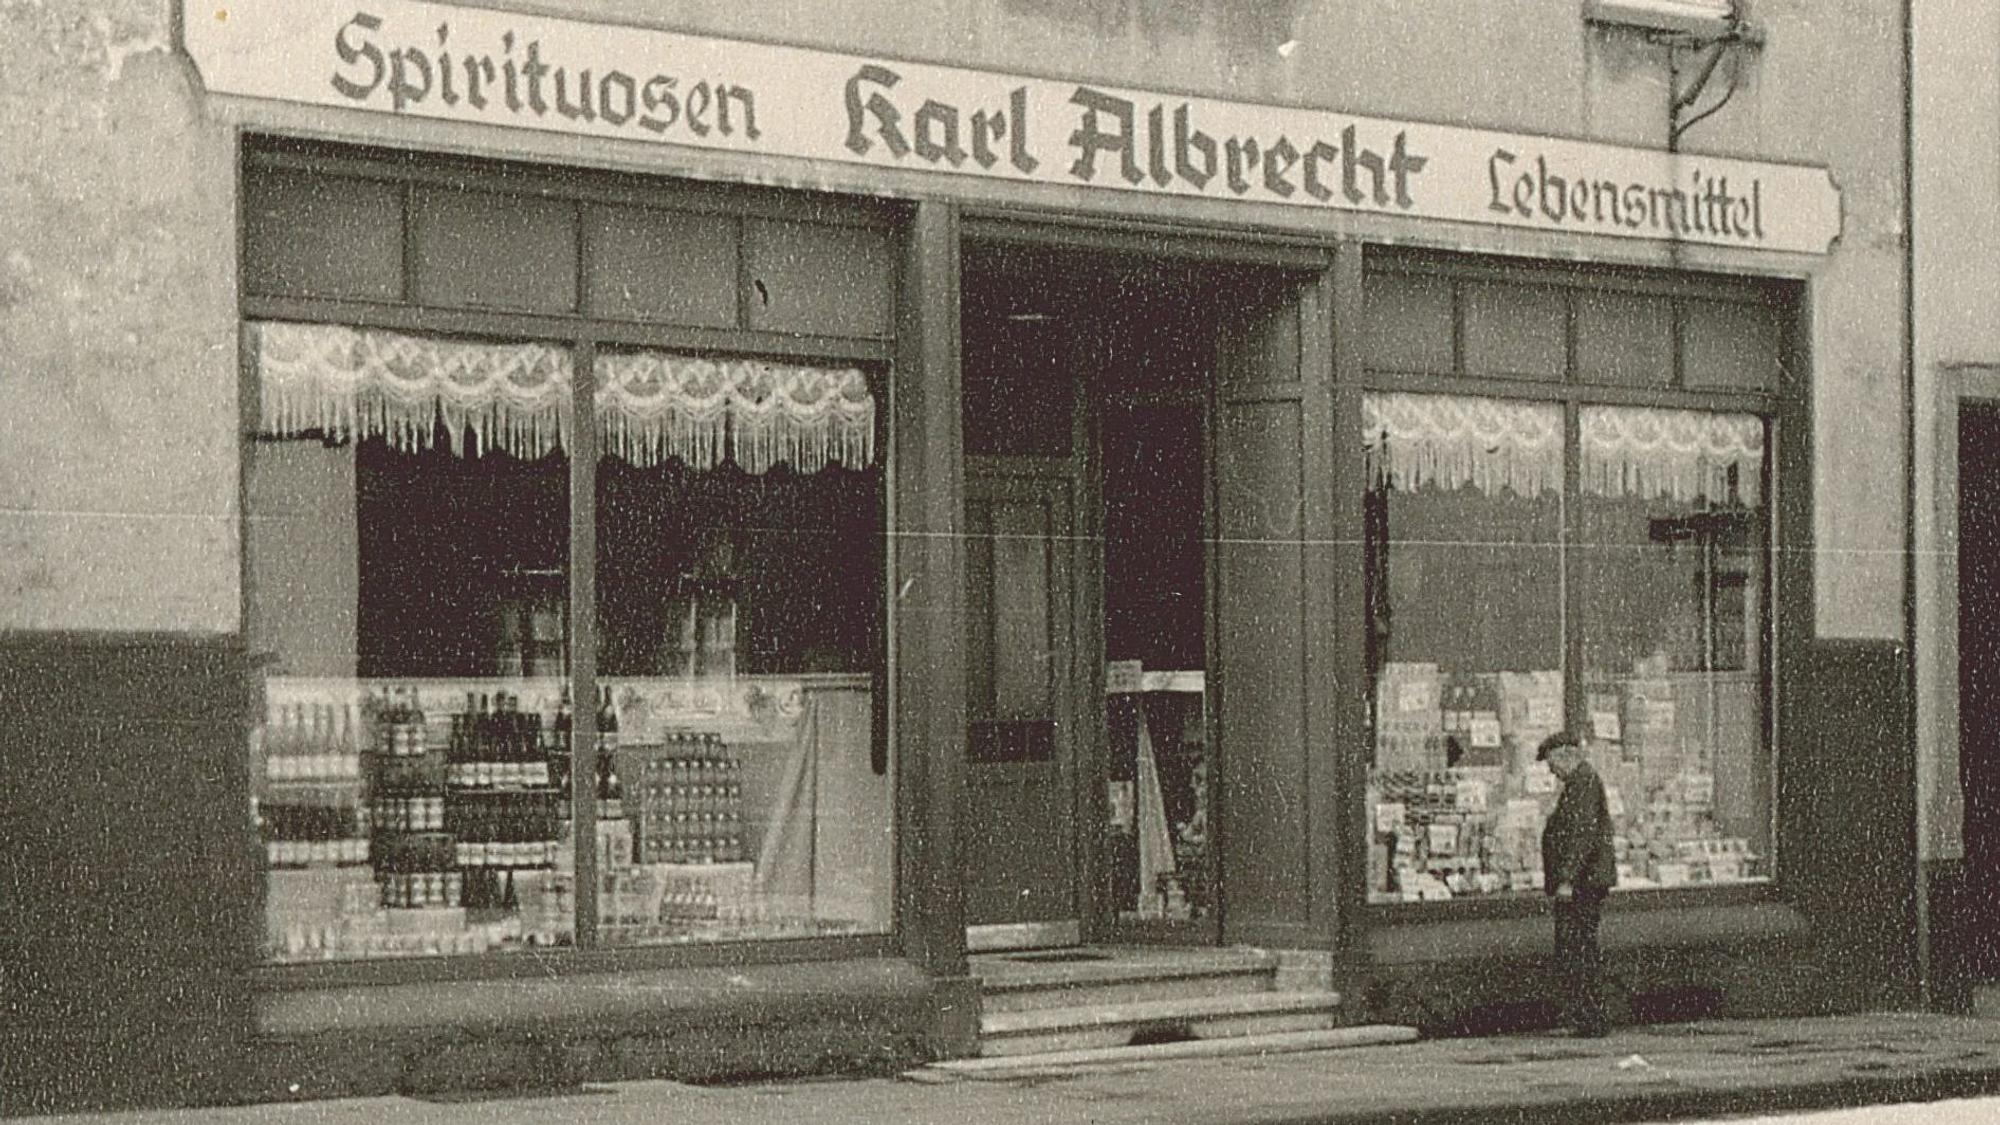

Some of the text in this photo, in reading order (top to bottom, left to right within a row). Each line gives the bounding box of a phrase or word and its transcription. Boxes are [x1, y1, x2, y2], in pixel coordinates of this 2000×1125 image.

[331, 12, 1764, 239] Spirituosen Karl Albrecht Lebensmittel
